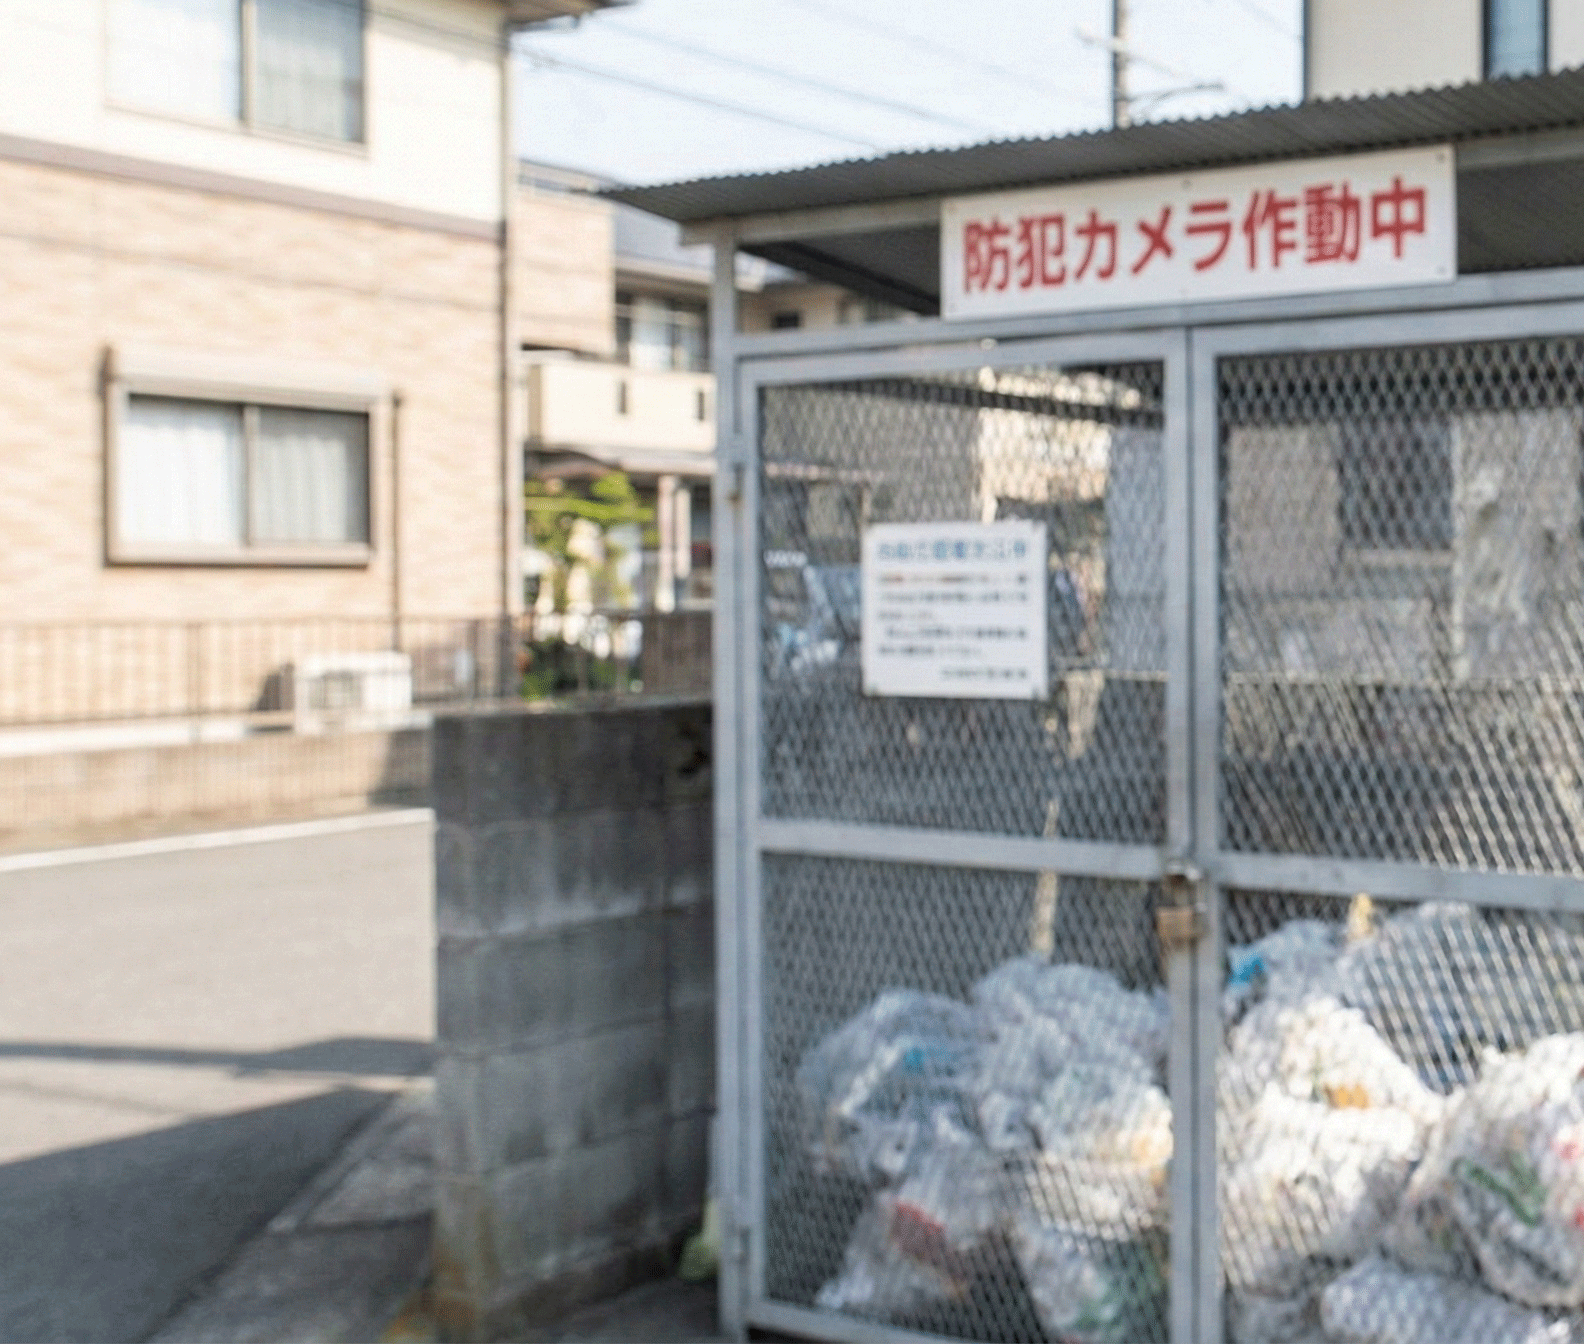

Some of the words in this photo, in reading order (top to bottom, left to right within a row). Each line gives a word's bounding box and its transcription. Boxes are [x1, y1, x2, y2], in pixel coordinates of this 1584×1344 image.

[963, 177, 1427, 292] 防犯カメラ作動中
